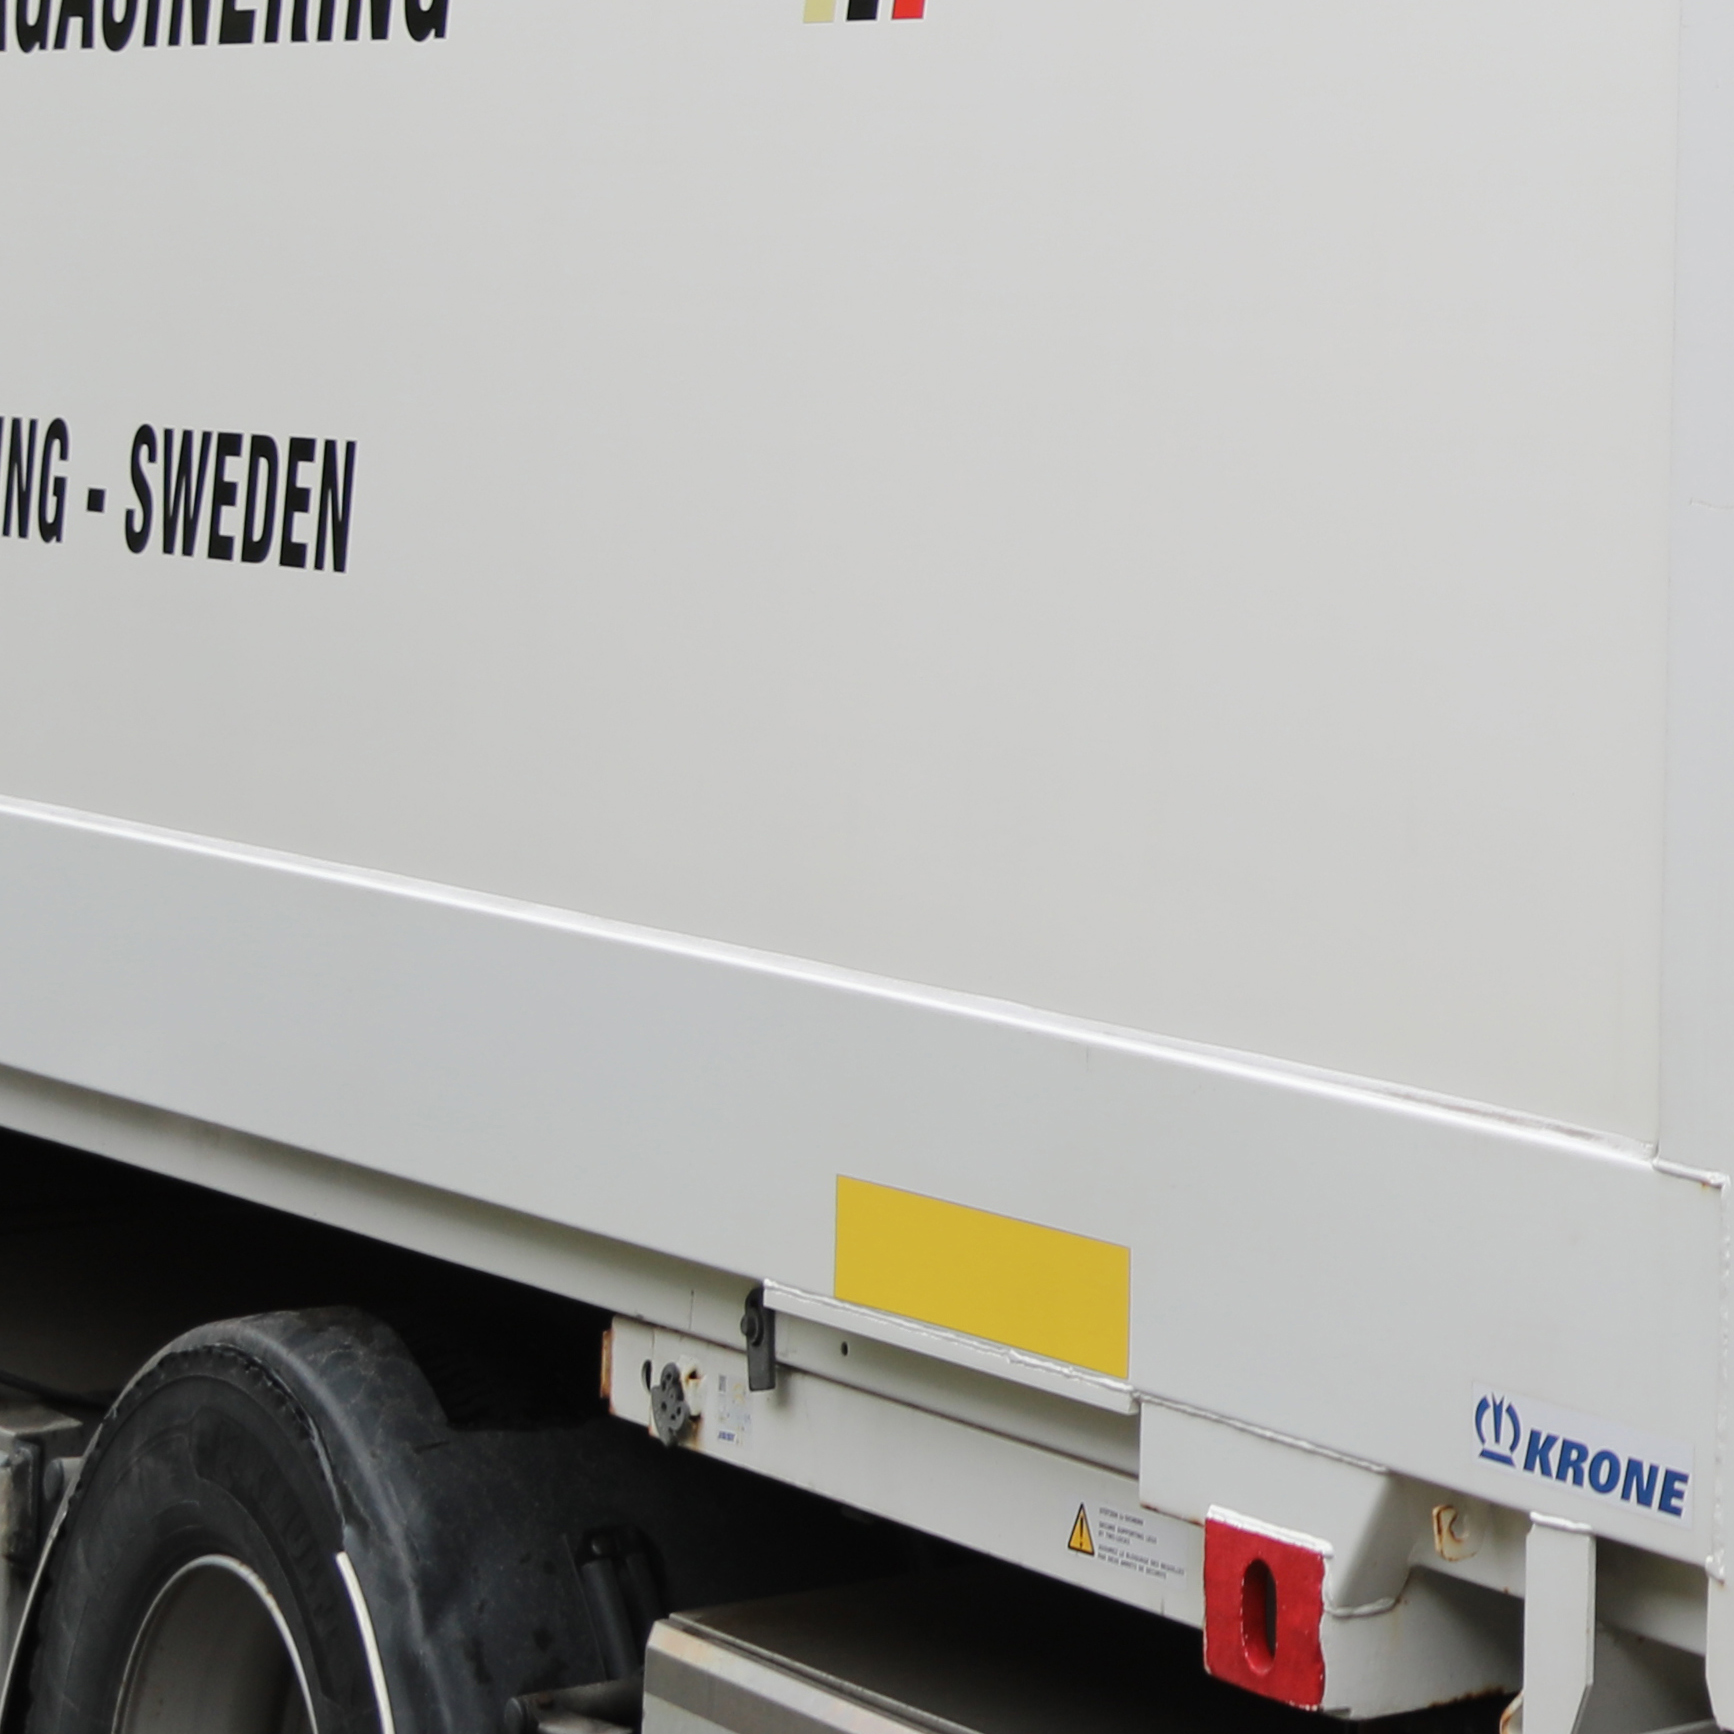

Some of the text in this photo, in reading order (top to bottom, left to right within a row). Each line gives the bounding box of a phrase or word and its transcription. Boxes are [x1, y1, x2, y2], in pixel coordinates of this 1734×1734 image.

[0, 416, 69, 544] NG
[125, 423, 357, 574] SWEDEN
[1522, 1426, 1690, 1521] KRONE
